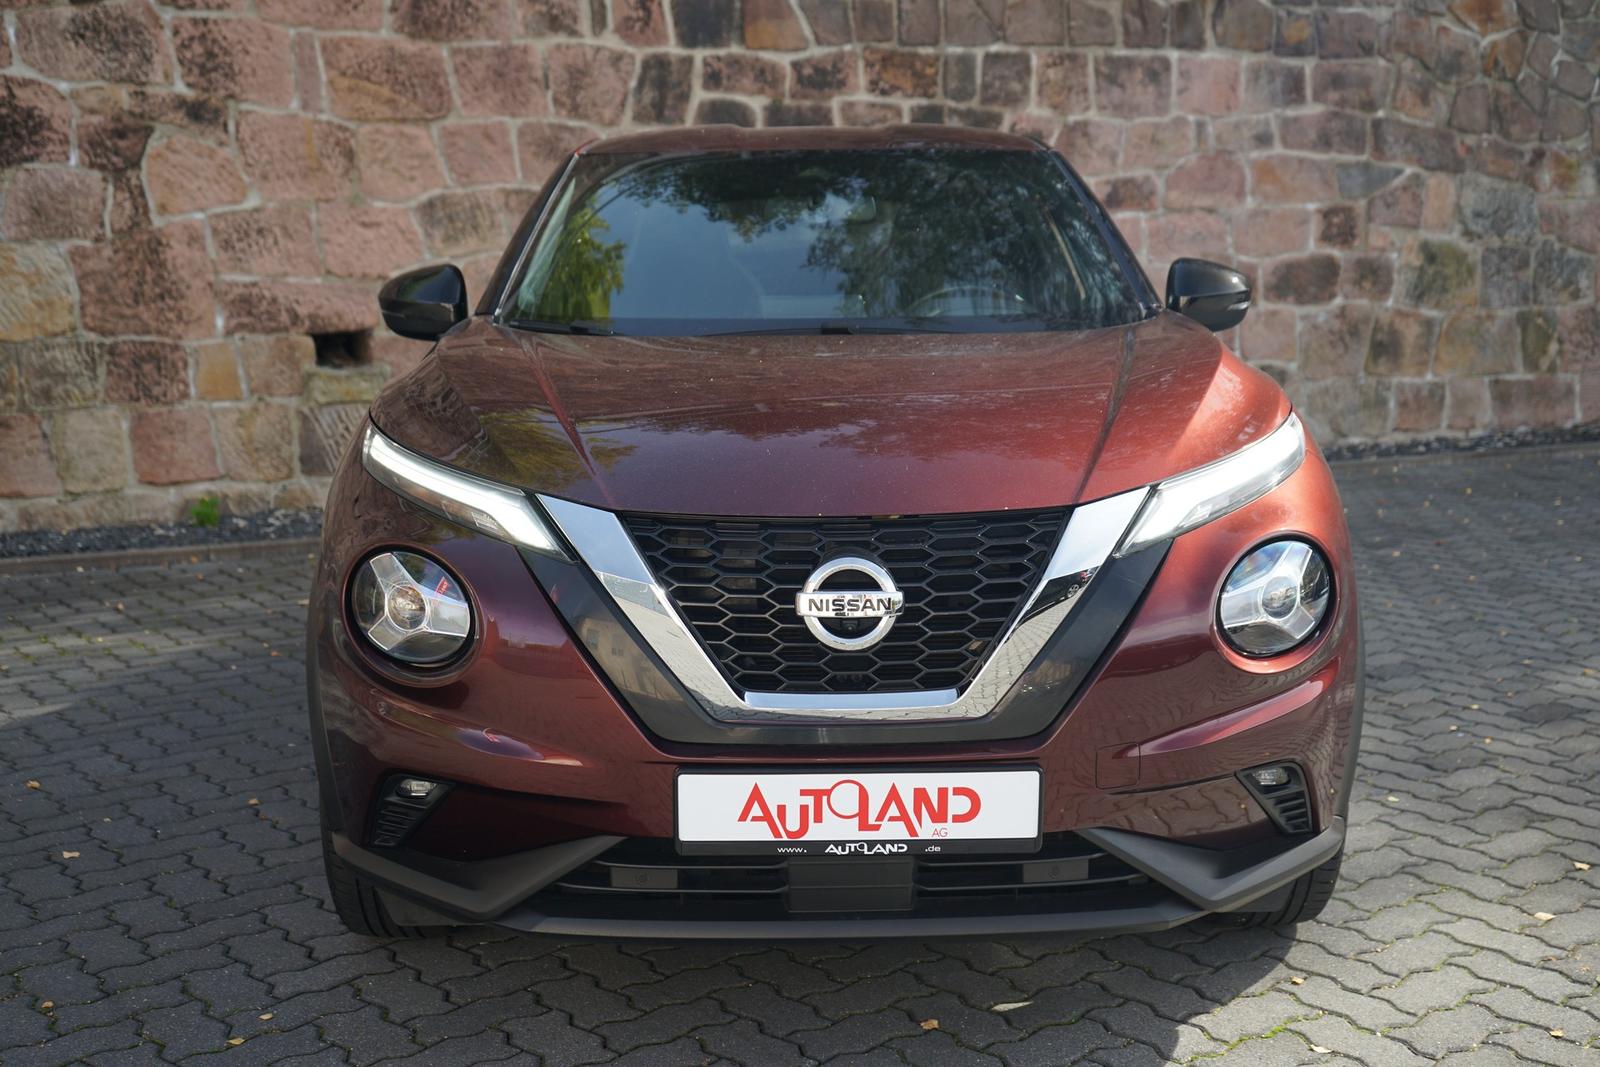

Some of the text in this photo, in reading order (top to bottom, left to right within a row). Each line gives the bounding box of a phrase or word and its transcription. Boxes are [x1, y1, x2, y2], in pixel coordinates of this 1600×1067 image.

[808, 597, 892, 612] NISSAN
[737, 779, 982, 840] AUTOLAND
[931, 827, 948, 838] AG
[776, 841, 942, 856] www. AUTOLAND .de
